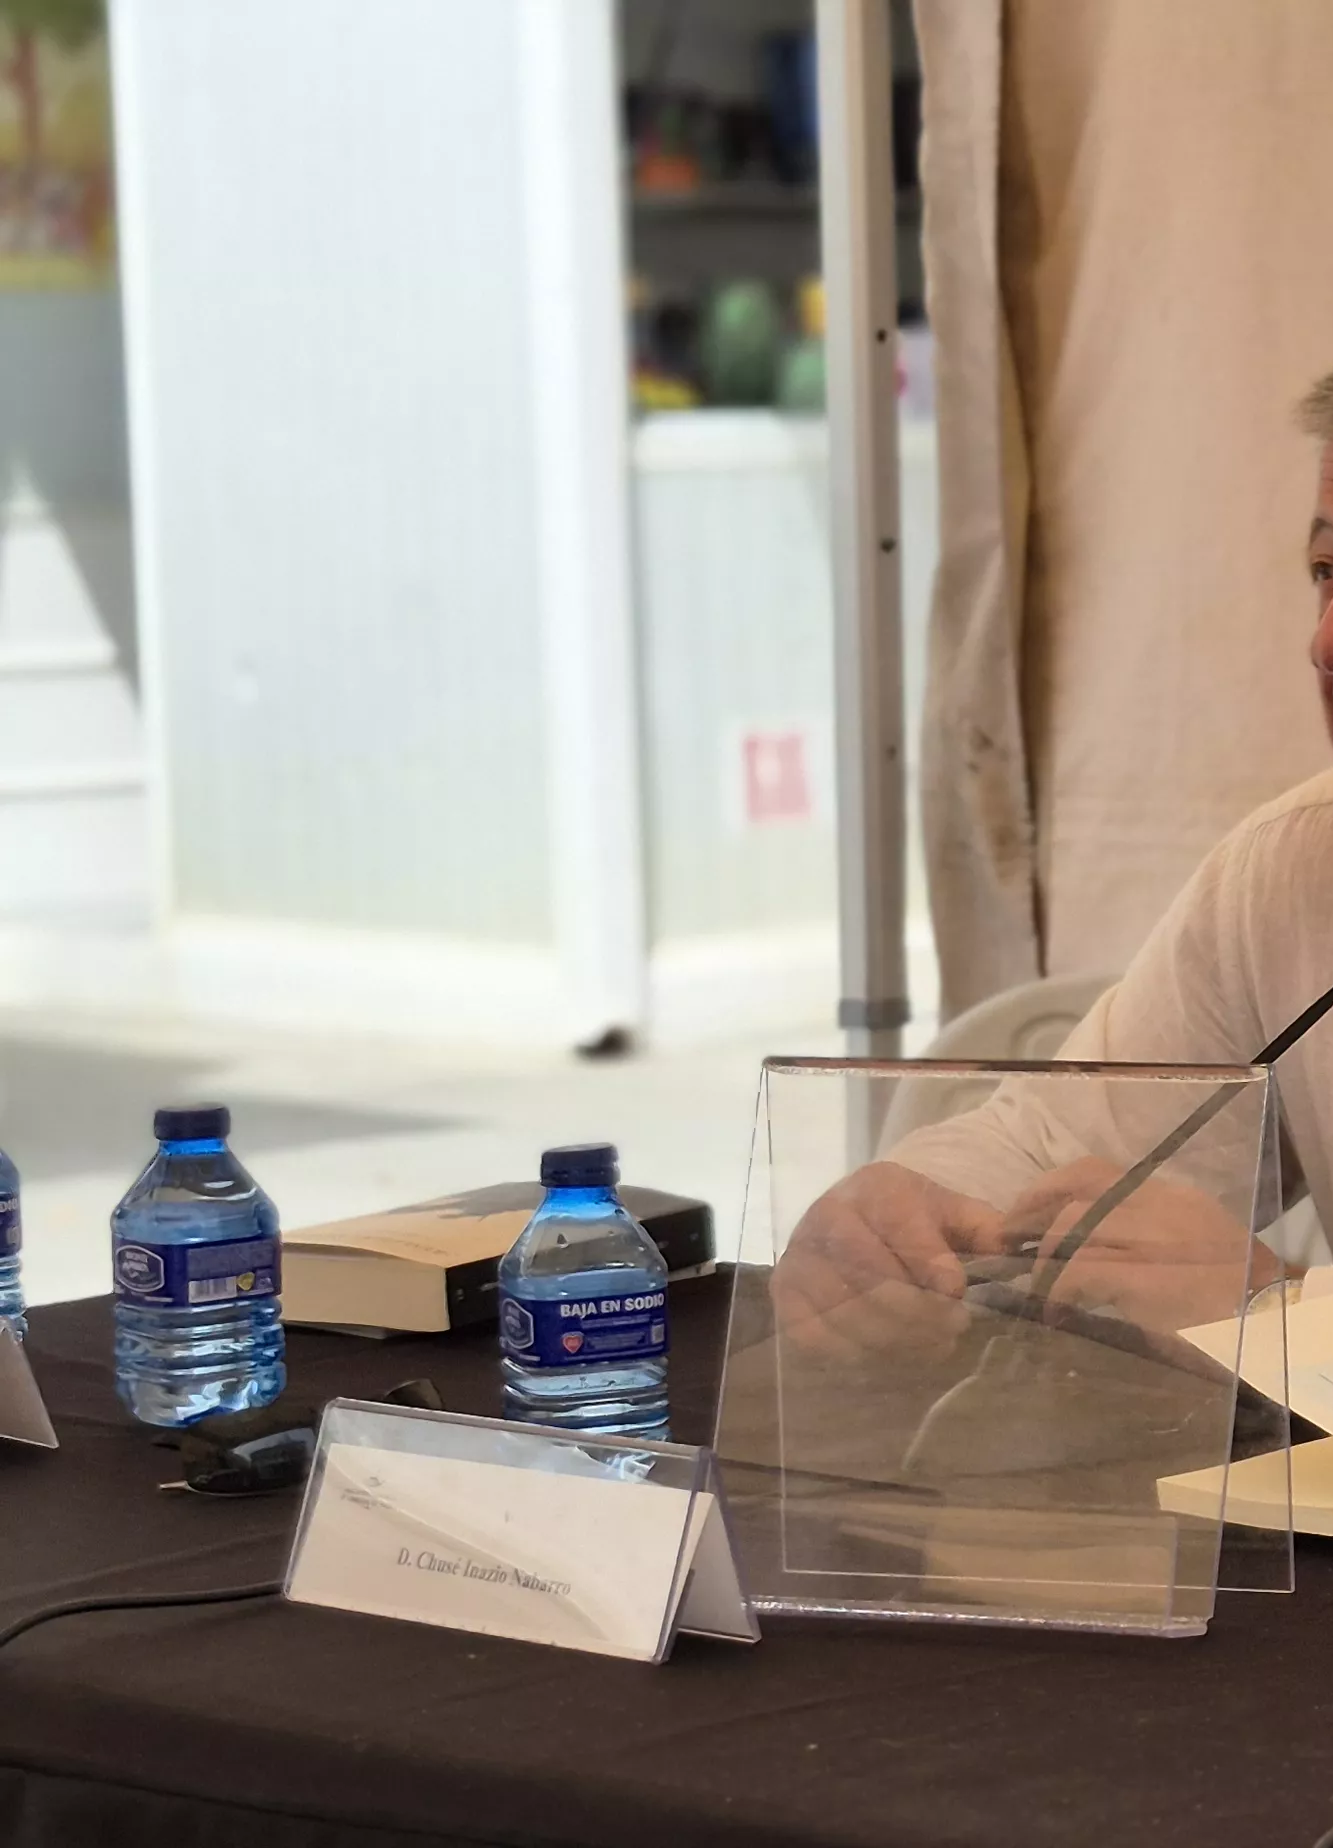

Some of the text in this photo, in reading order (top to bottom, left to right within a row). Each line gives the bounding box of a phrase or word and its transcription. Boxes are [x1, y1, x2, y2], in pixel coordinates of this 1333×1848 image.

[560, 1293, 665, 1319] BAJA EN SODIO
[397, 1547, 412, 1566] D.
[417, 1550, 462, 1576] Chusé
[463, 1559, 508, 1583] Inazio
